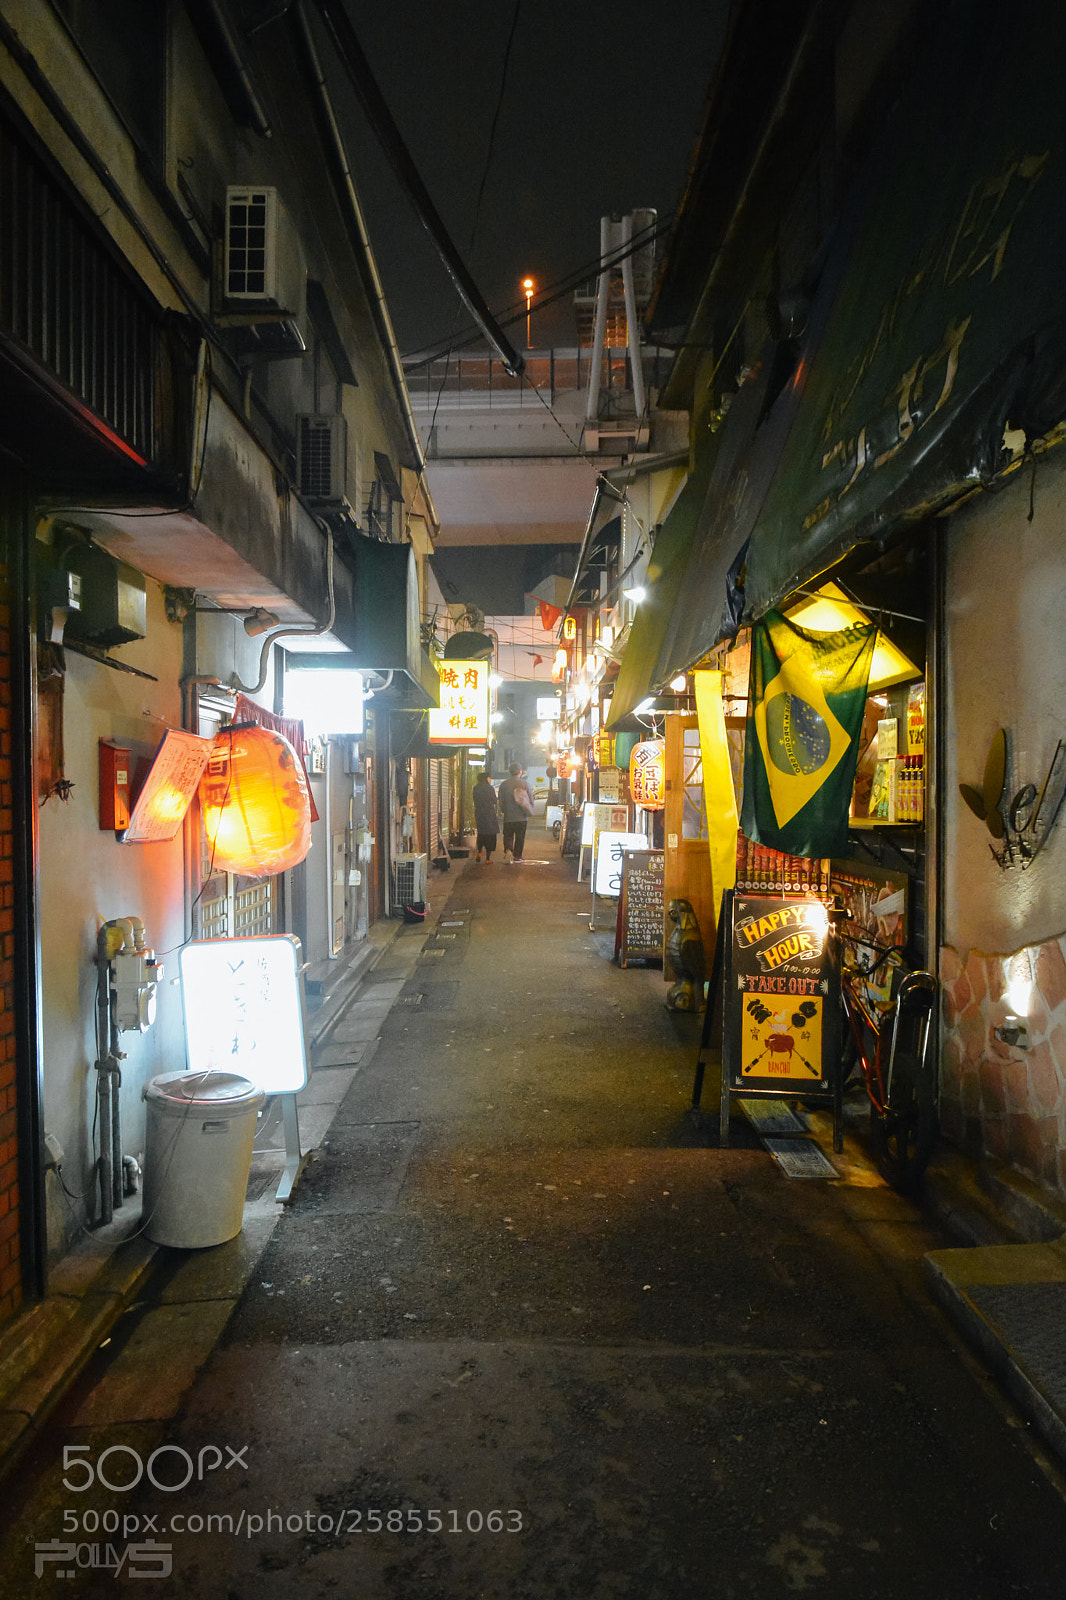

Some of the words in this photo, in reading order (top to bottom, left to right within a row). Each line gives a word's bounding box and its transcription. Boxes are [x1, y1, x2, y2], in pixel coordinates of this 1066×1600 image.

[438, 667, 479, 690] 焼肉
[448, 714, 478, 729] 料理
[742, 906, 804, 944] HAPPY
[763, 933, 815, 969] HOUR
[745, 974, 787, 993] TAKE
[788, 977, 819, 995] OUT
[767, 1060, 791, 1075] RANCHO
